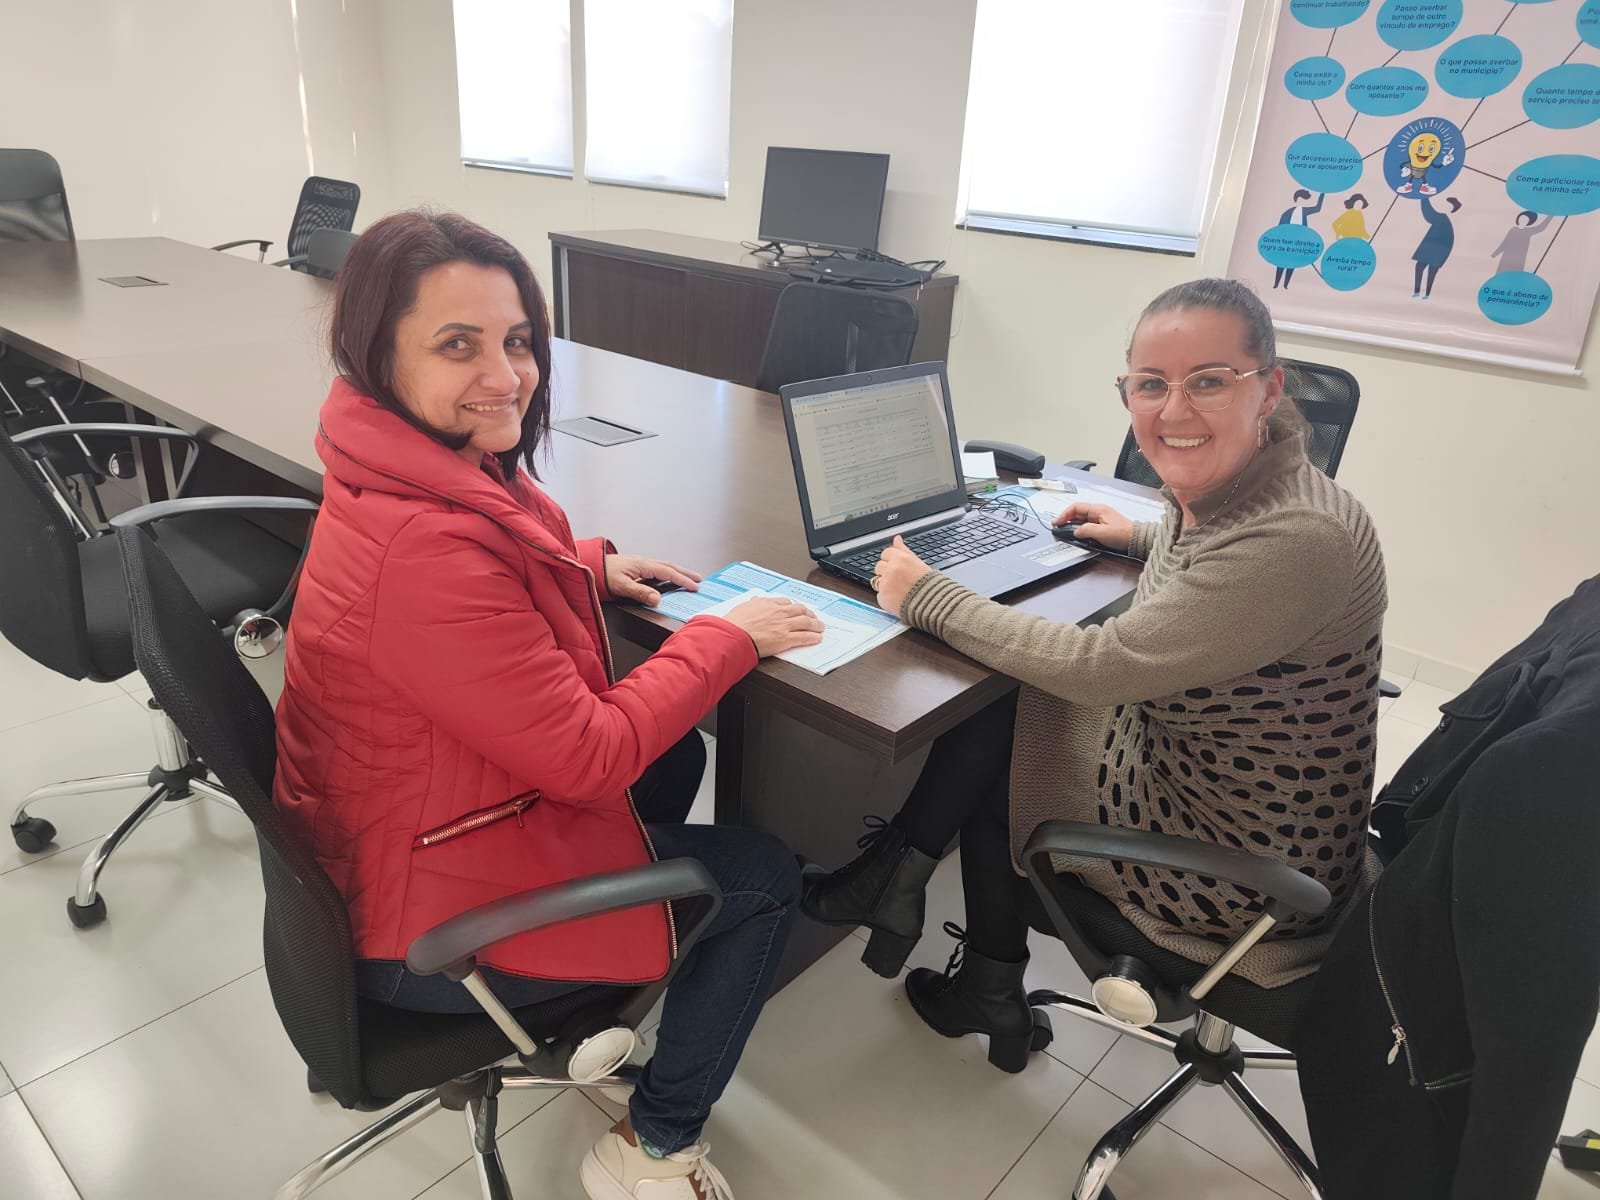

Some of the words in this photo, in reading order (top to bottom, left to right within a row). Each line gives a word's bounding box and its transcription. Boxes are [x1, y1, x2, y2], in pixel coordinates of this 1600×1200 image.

[1418, 22, 1456, 30] emprego?
[1535, 87, 1565, 95] Quanto
[1567, 88, 1593, 96] tempo
[1528, 96, 1556, 104] serviço
[1559, 97, 1590, 105] preciso
[1302, 154, 1336, 162] documento
[1541, 177, 1583, 185] particionar
[1326, 255, 1350, 263] Averba
[1350, 258, 1371, 266] tempo
[1483, 286, 1490, 294] O
[1513, 291, 1537, 299] abono
